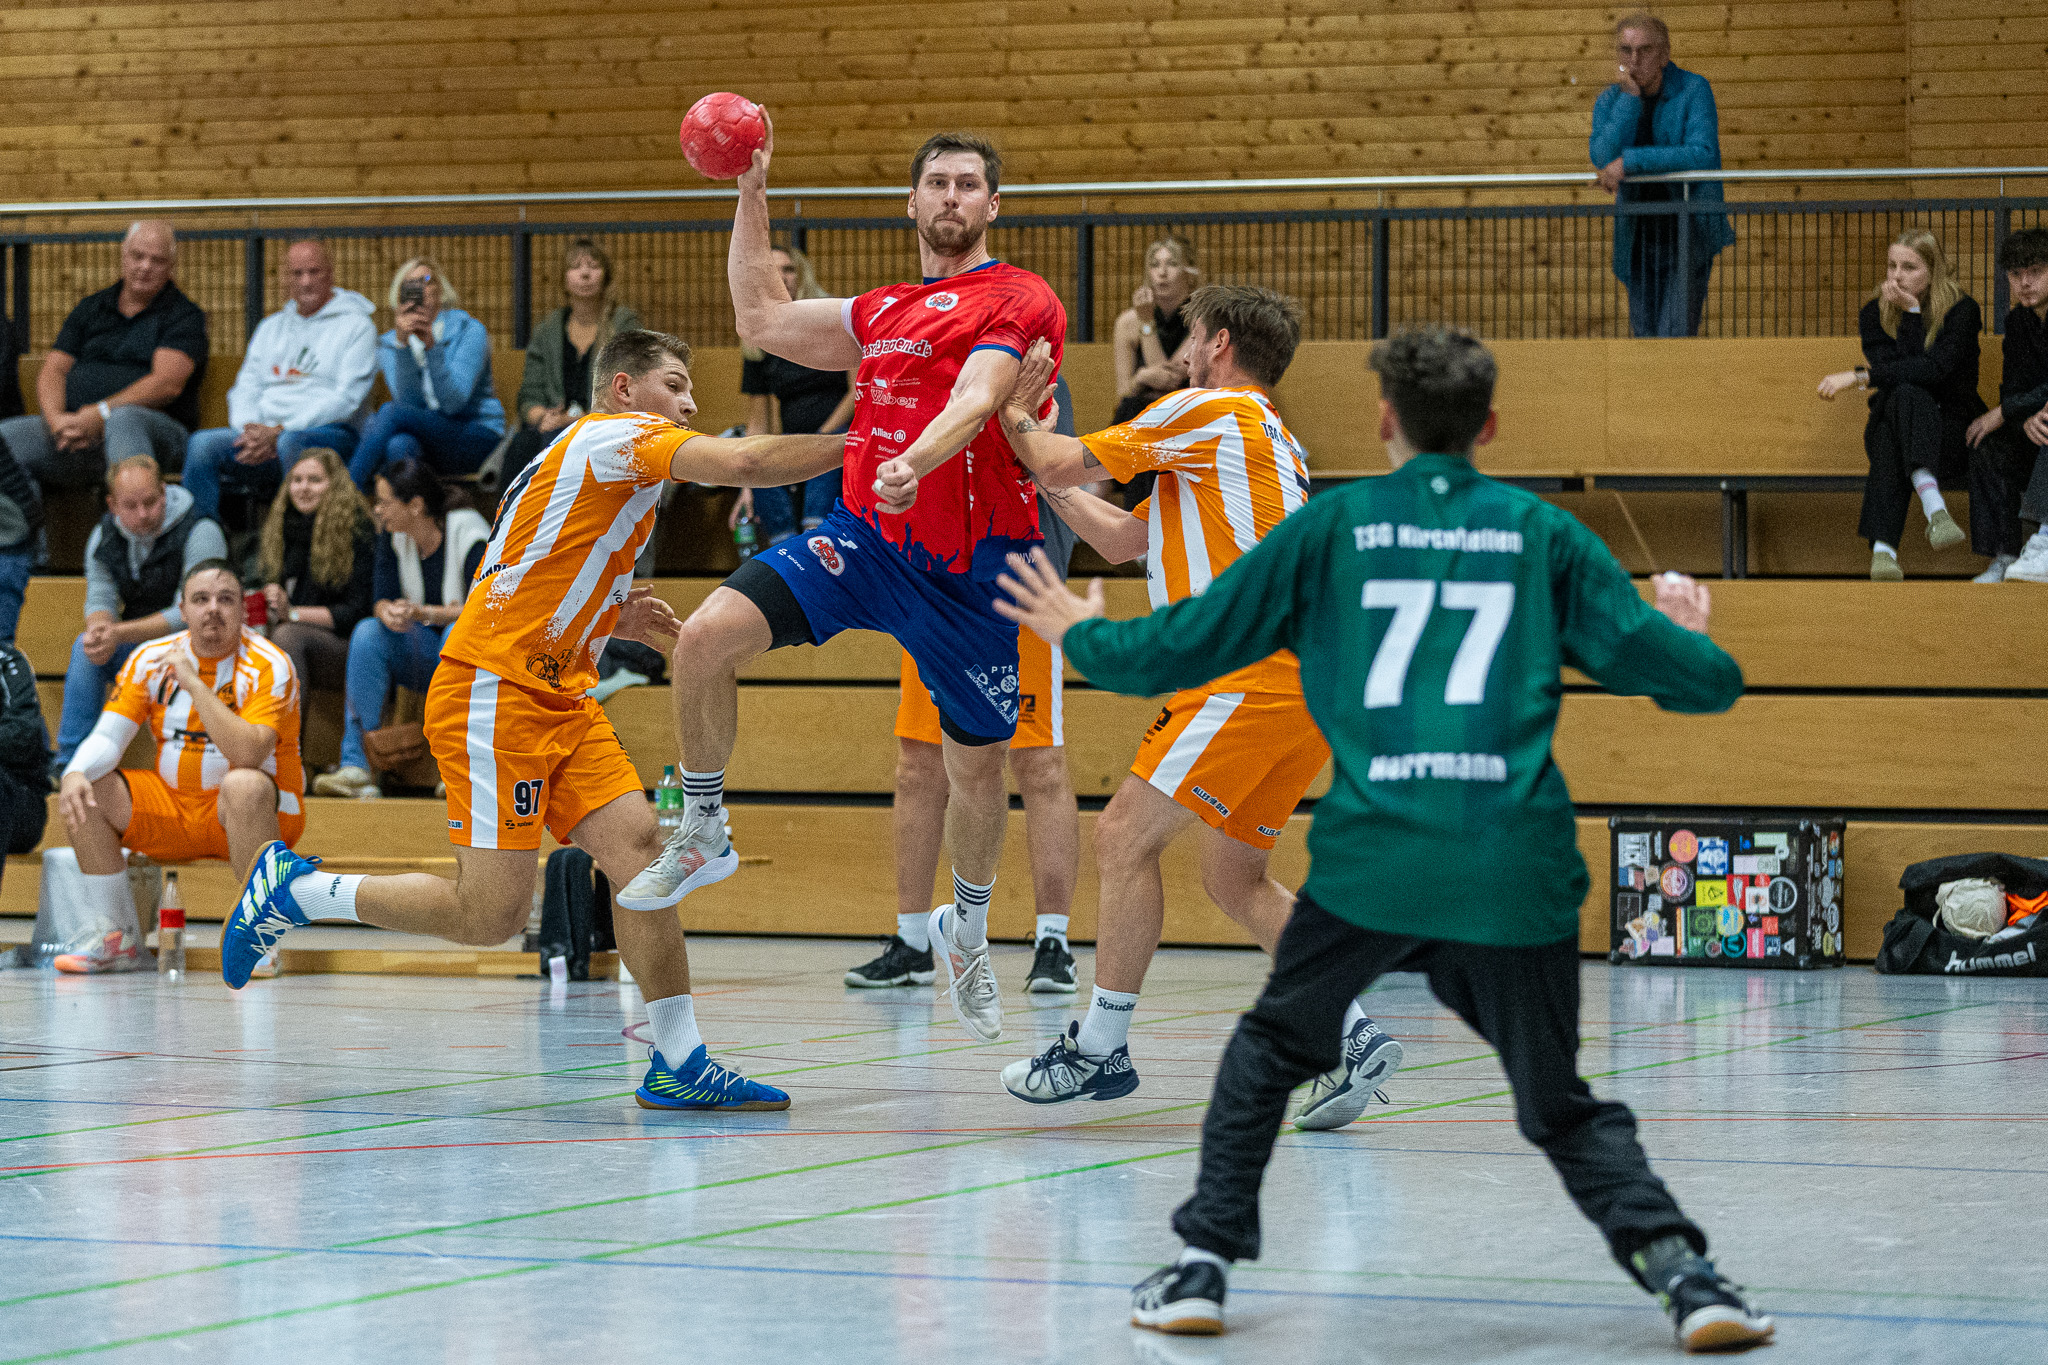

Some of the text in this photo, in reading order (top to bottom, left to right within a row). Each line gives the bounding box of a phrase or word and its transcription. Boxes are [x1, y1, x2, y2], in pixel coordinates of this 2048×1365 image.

[1353, 521, 1394, 552] TSG
[814, 539, 841, 571] HSG
[1360, 579, 1516, 710] 77
[513, 779, 545, 818] 97
[1191, 785, 1211, 802] ALLES
[1215, 802, 1230, 817] DEN
[1943, 941, 2037, 974] hummel
